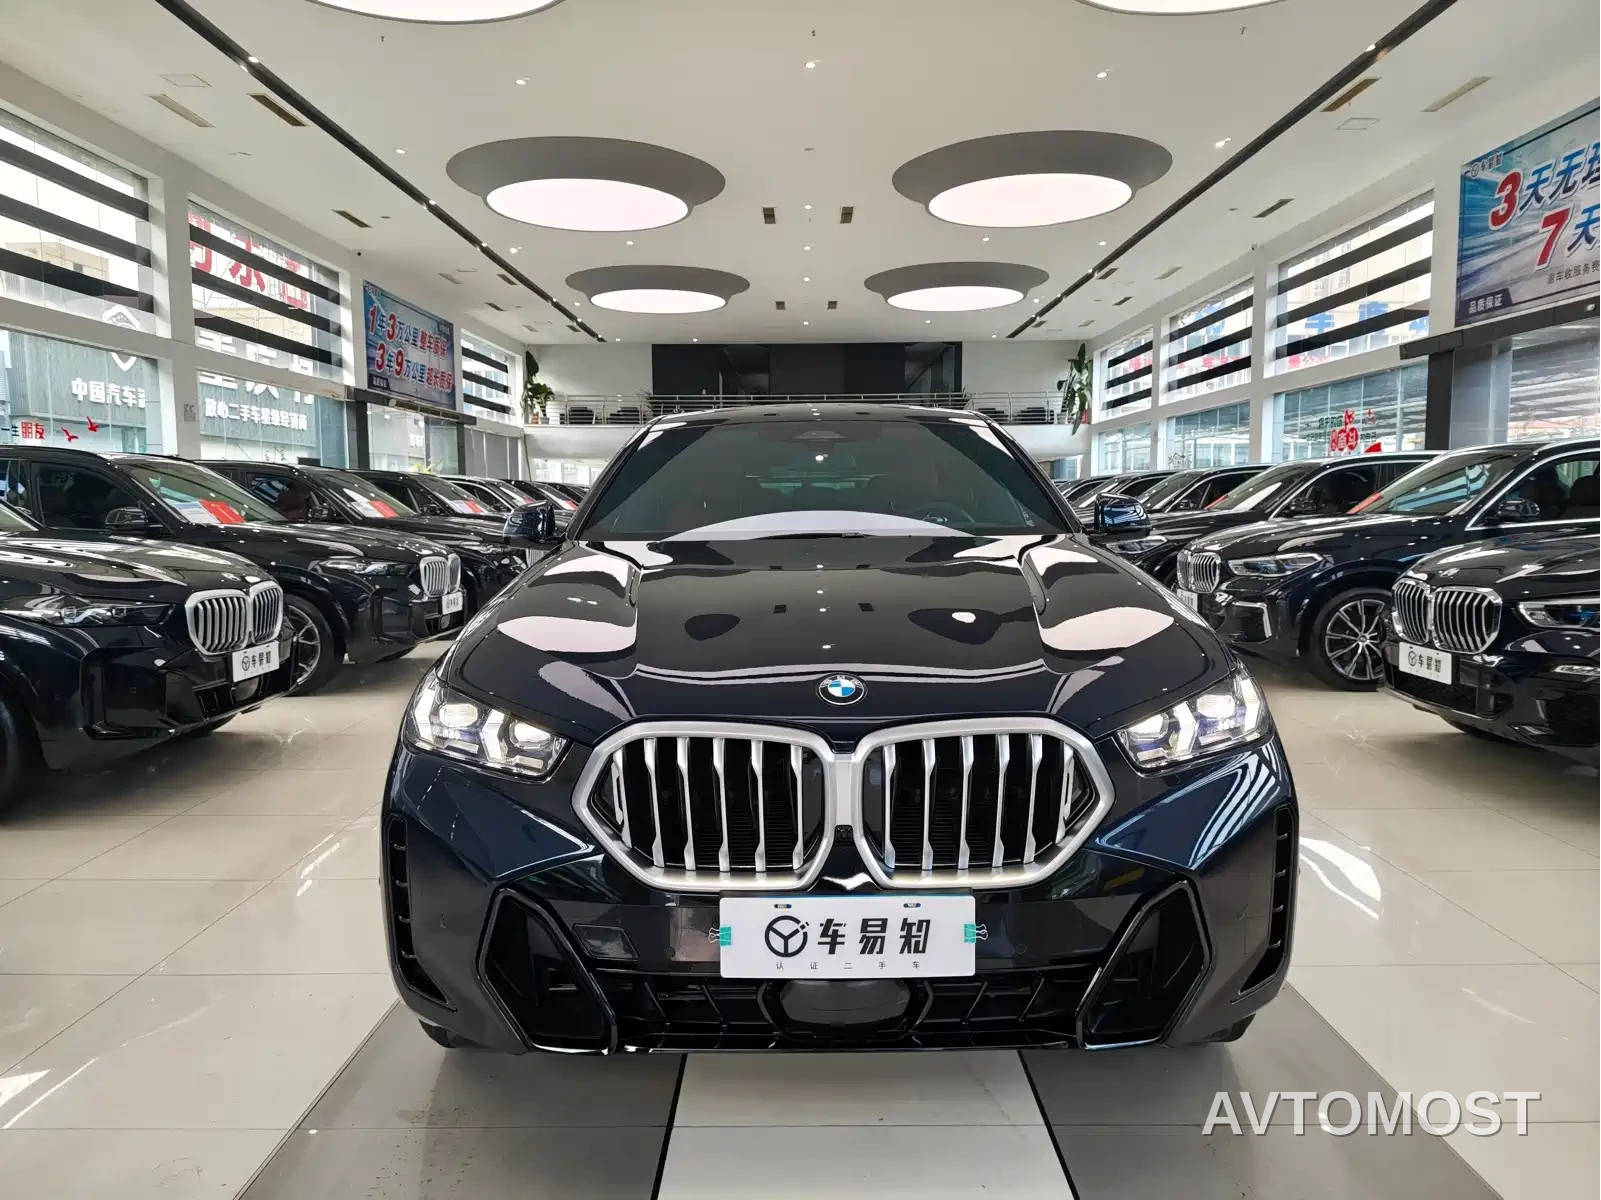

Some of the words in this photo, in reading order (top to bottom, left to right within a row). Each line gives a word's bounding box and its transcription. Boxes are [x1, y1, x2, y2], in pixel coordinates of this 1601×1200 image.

[1468, 294, 1503, 314] 品质保证
[817, 918, 931, 955] 车易知
[775, 961, 921, 970] 认证二手车
